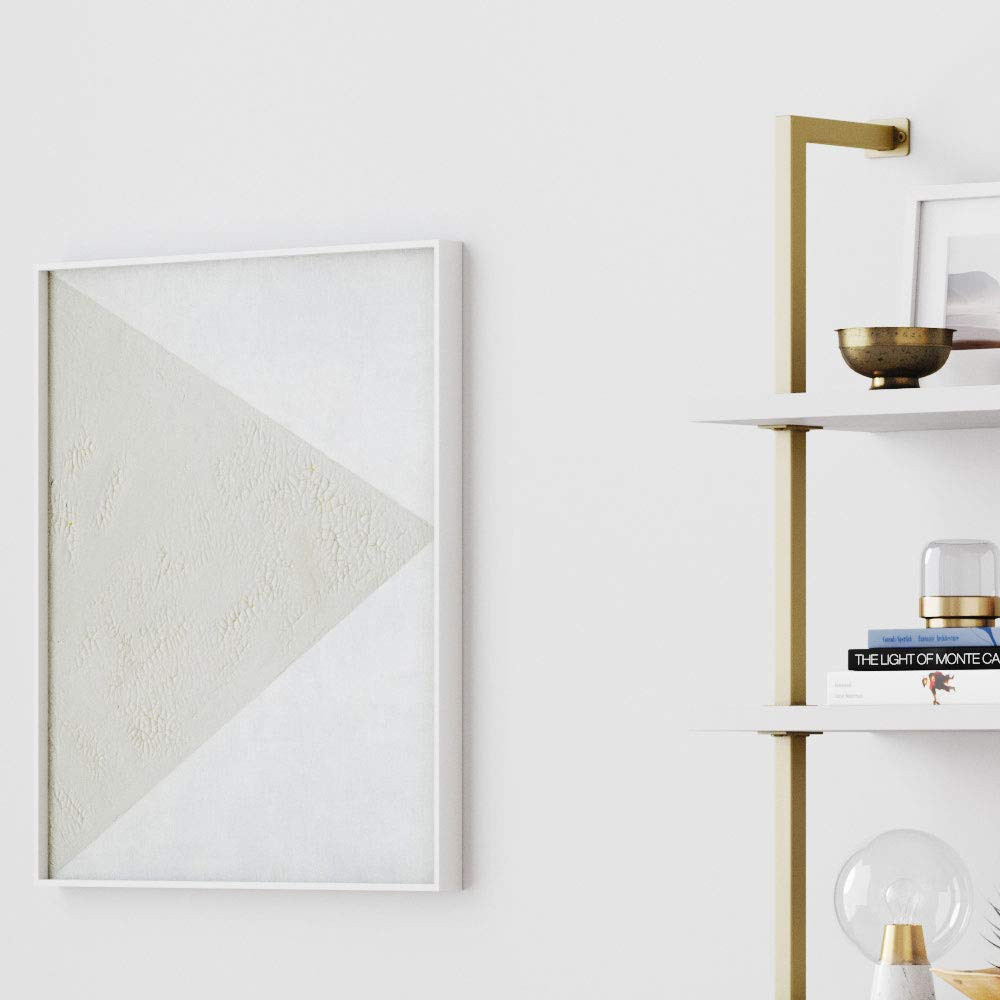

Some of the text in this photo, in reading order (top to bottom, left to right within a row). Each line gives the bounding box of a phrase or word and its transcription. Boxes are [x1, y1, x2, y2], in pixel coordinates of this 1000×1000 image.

[854, 653, 879, 666] THE
[880, 653, 915, 666] LIGHT
[916, 652, 934, 665] OF
[935, 652, 981, 665] MONTE
